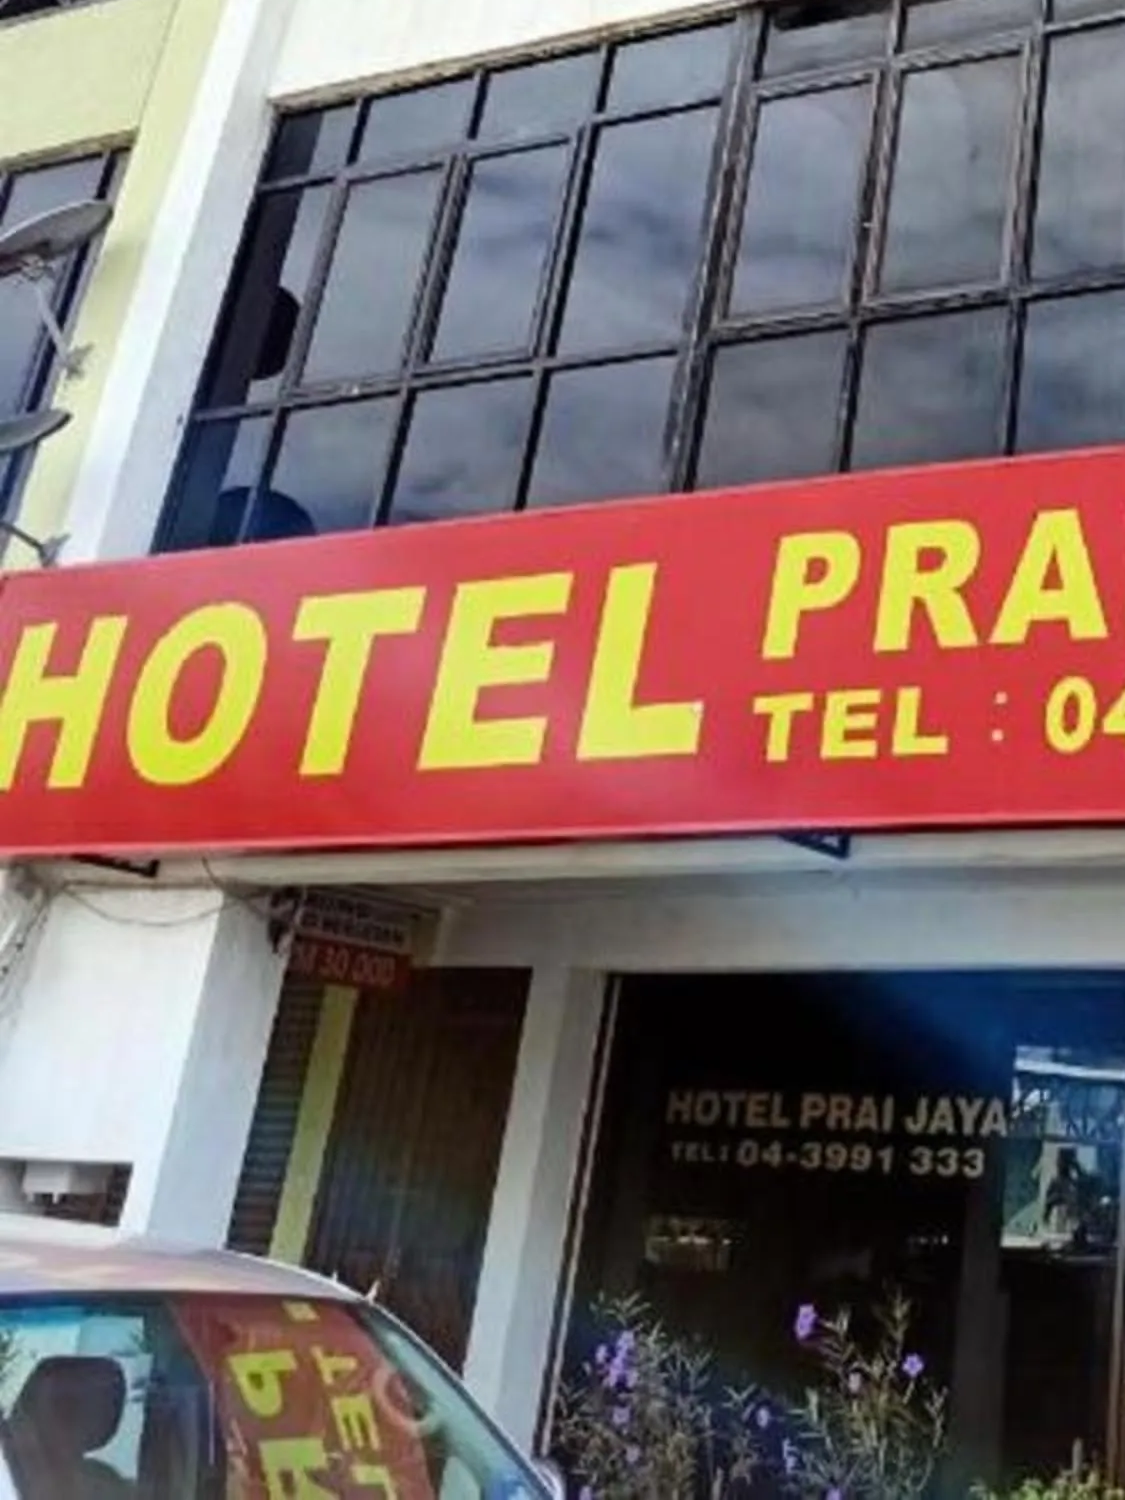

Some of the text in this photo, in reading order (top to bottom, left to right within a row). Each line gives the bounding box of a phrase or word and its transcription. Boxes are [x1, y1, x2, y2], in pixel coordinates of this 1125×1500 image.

[0, 563, 703, 790] HOTEL
[753, 687, 948, 762] TEL
[666, 1089, 1008, 1138] HOTEL PRAI JAYA
[736, 1139, 894, 1175] 04-3991
[909, 1144, 986, 1179] 333
